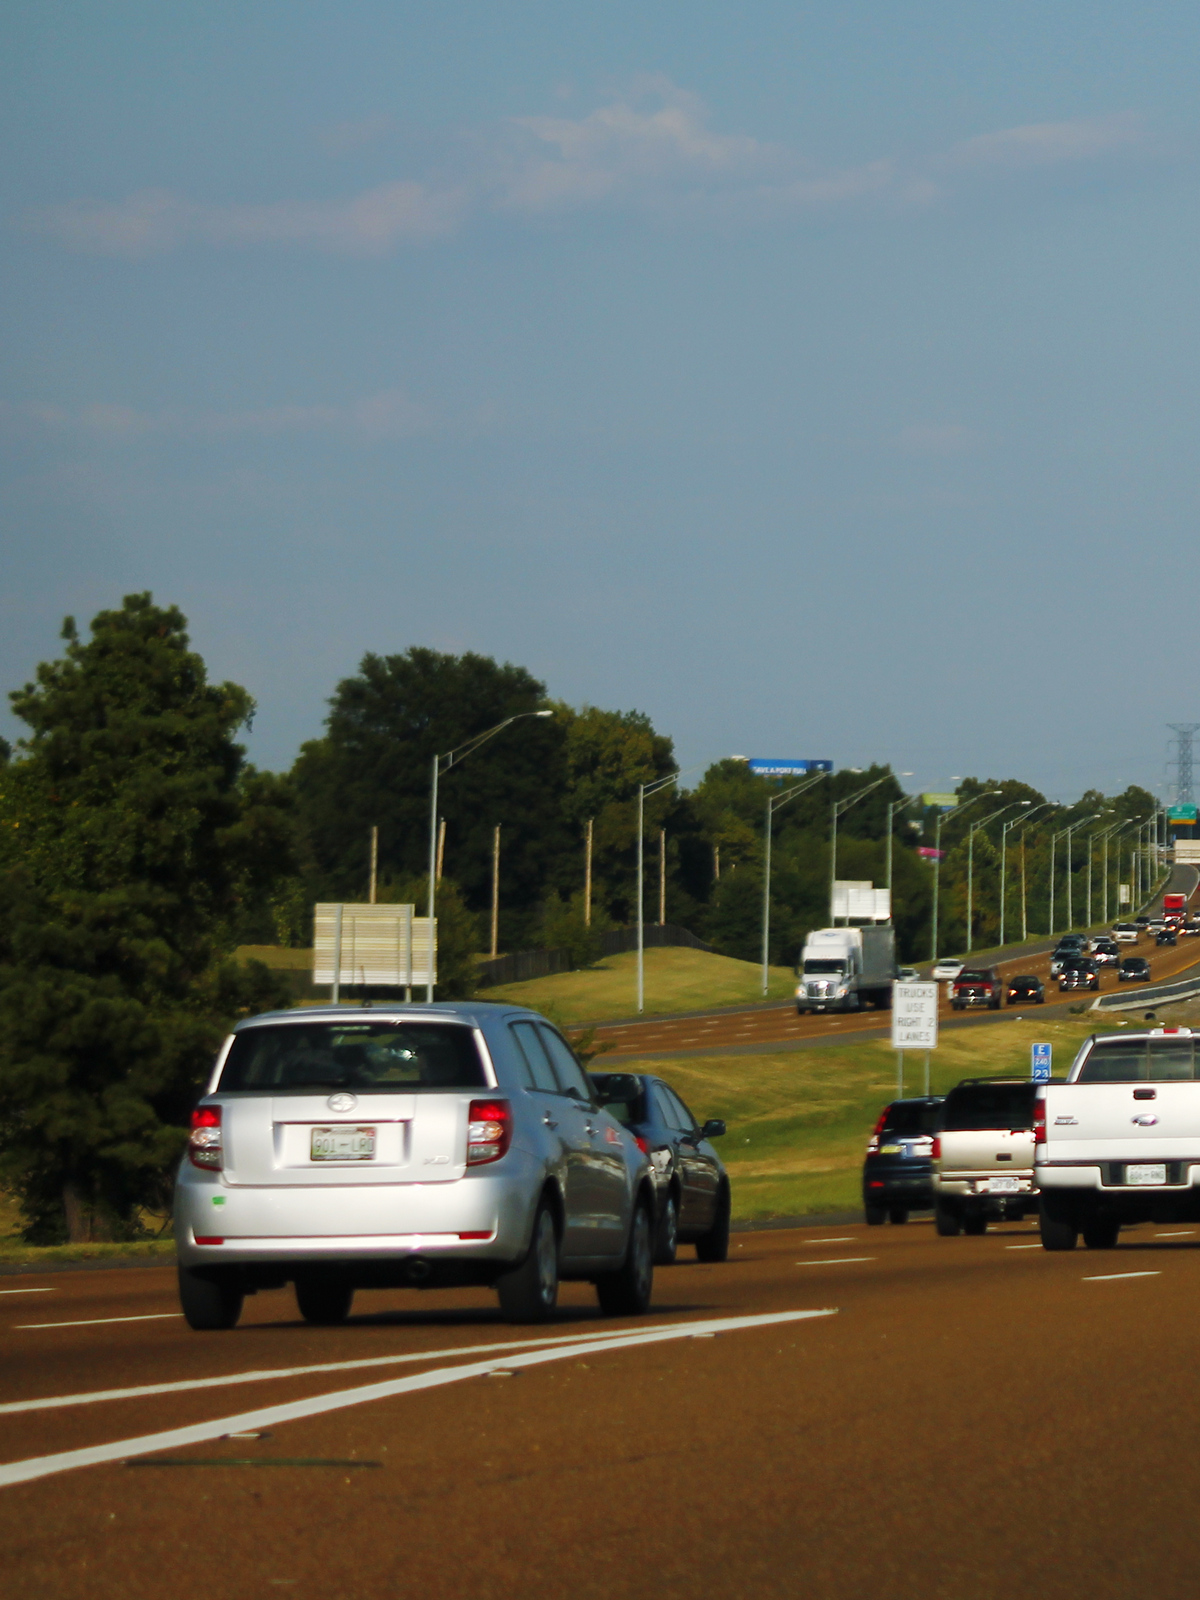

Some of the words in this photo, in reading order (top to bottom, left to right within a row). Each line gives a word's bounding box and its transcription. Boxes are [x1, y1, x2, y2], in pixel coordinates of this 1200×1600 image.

[899, 988, 934, 998] TRUCKS
[906, 1003, 925, 1012] USE
[898, 1017, 921, 1026] RIGHT
[928, 1017, 935, 1027] 2
[899, 1032, 931, 1041] LANES
[1038, 1045, 1046, 1055] E
